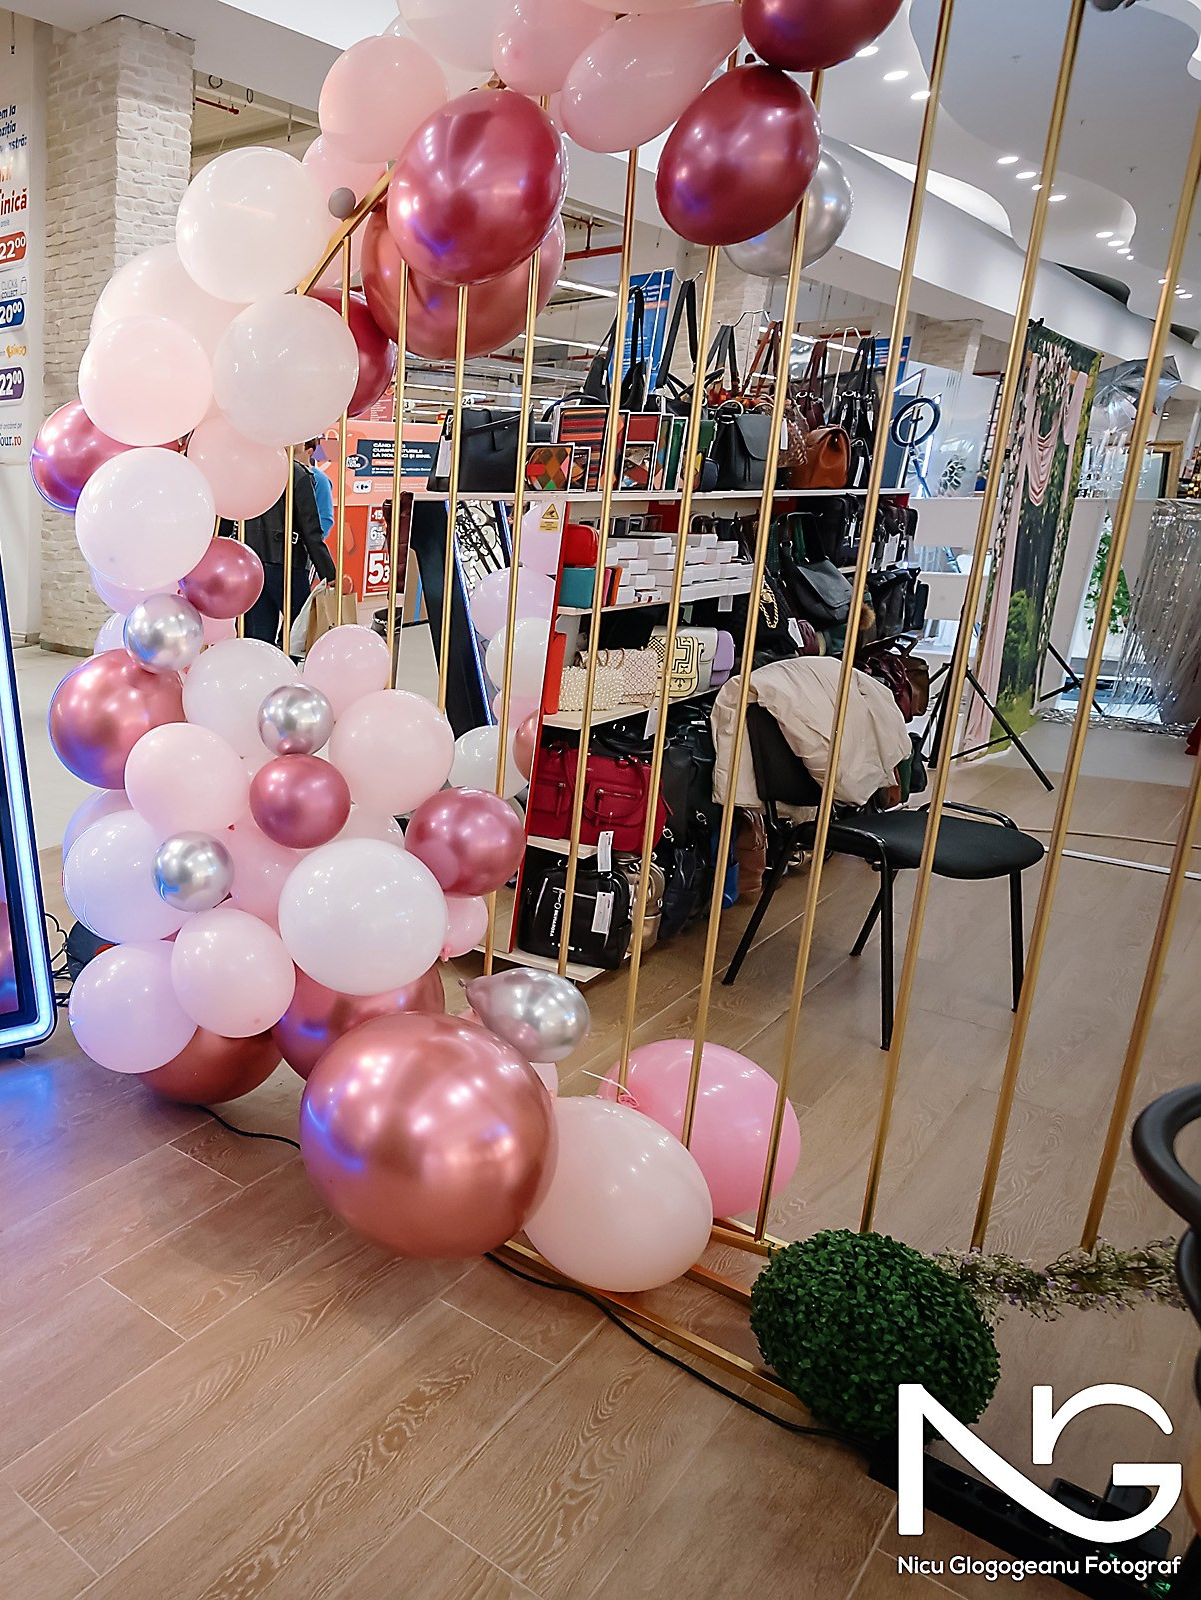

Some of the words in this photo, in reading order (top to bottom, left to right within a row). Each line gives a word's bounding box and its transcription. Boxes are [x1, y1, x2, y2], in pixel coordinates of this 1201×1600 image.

[9, 105, 17, 116] la
[372, 510, 384, 520] -15
[367, 552, 385, 584] 5
